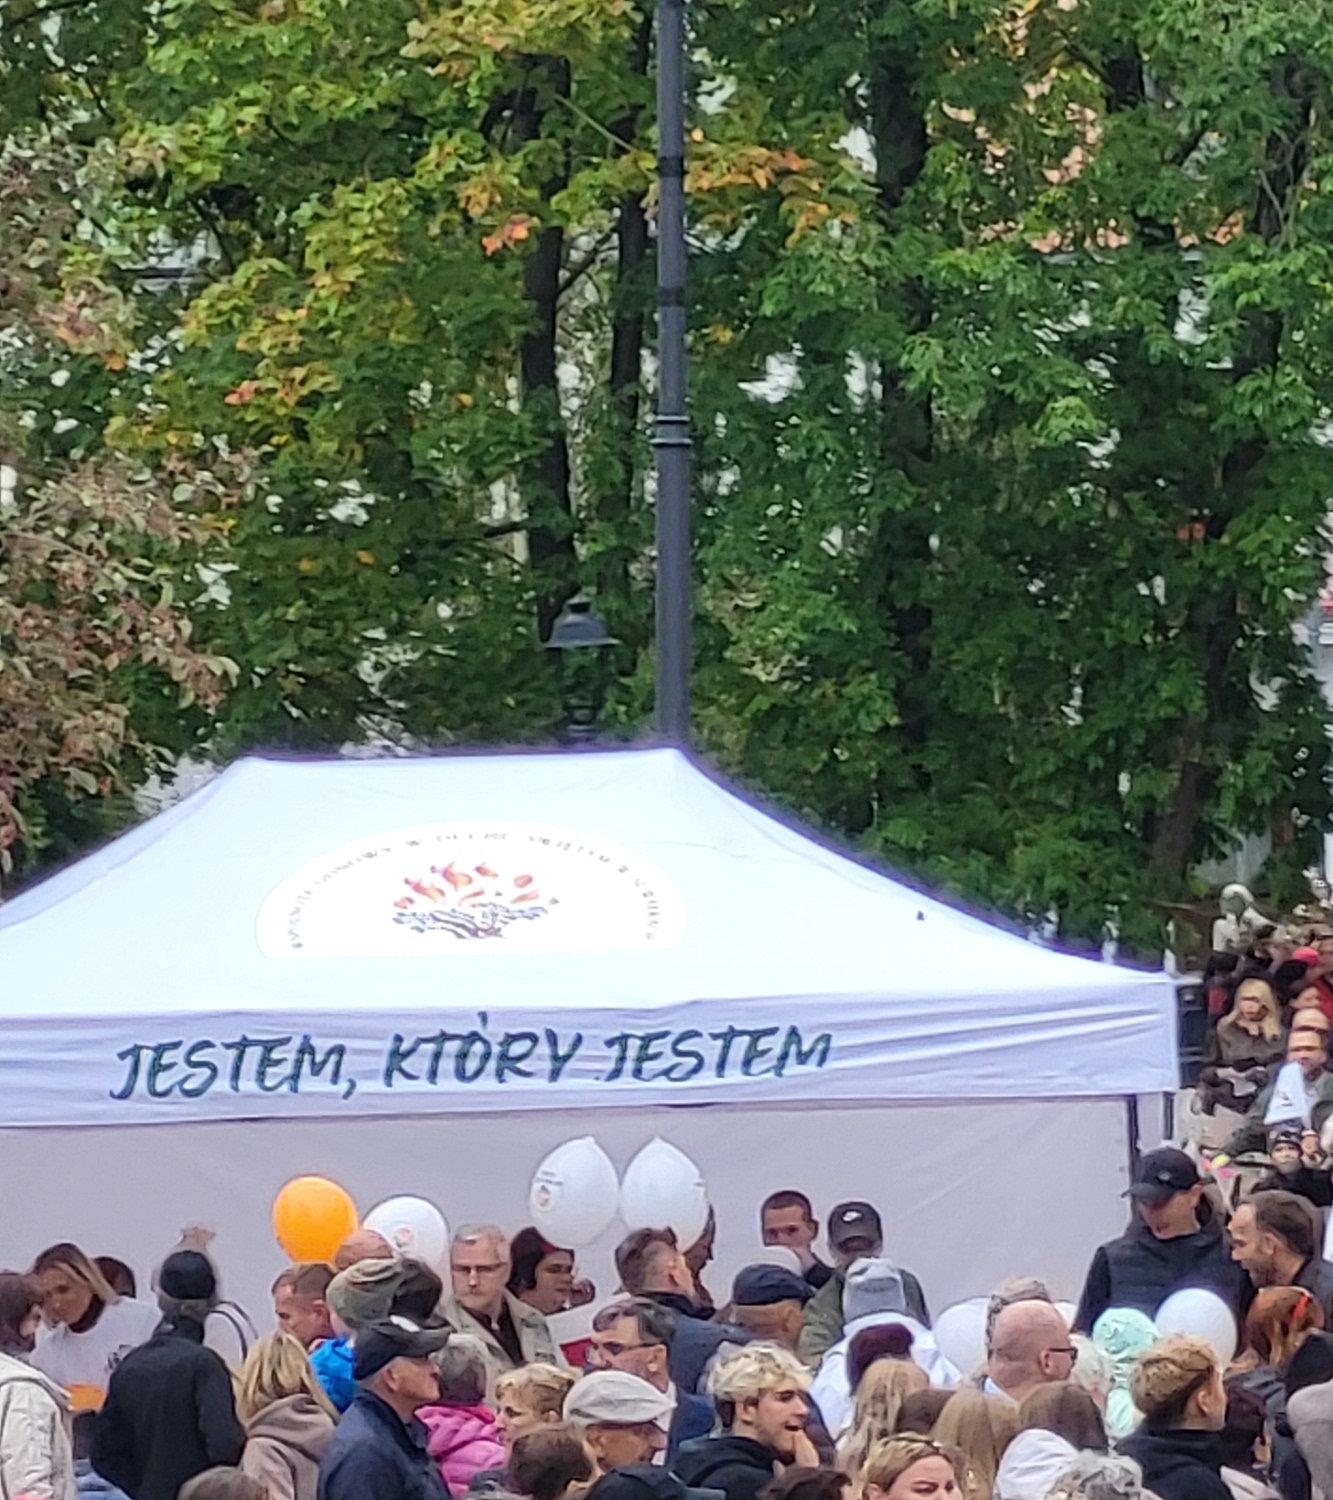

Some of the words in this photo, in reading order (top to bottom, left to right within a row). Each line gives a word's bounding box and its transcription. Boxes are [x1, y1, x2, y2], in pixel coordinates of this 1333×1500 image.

[109, 1033, 357, 1100] JESTEM,
[383, 1010, 583, 1084] KTÓRY
[595, 1023, 833, 1083] JESTEM
